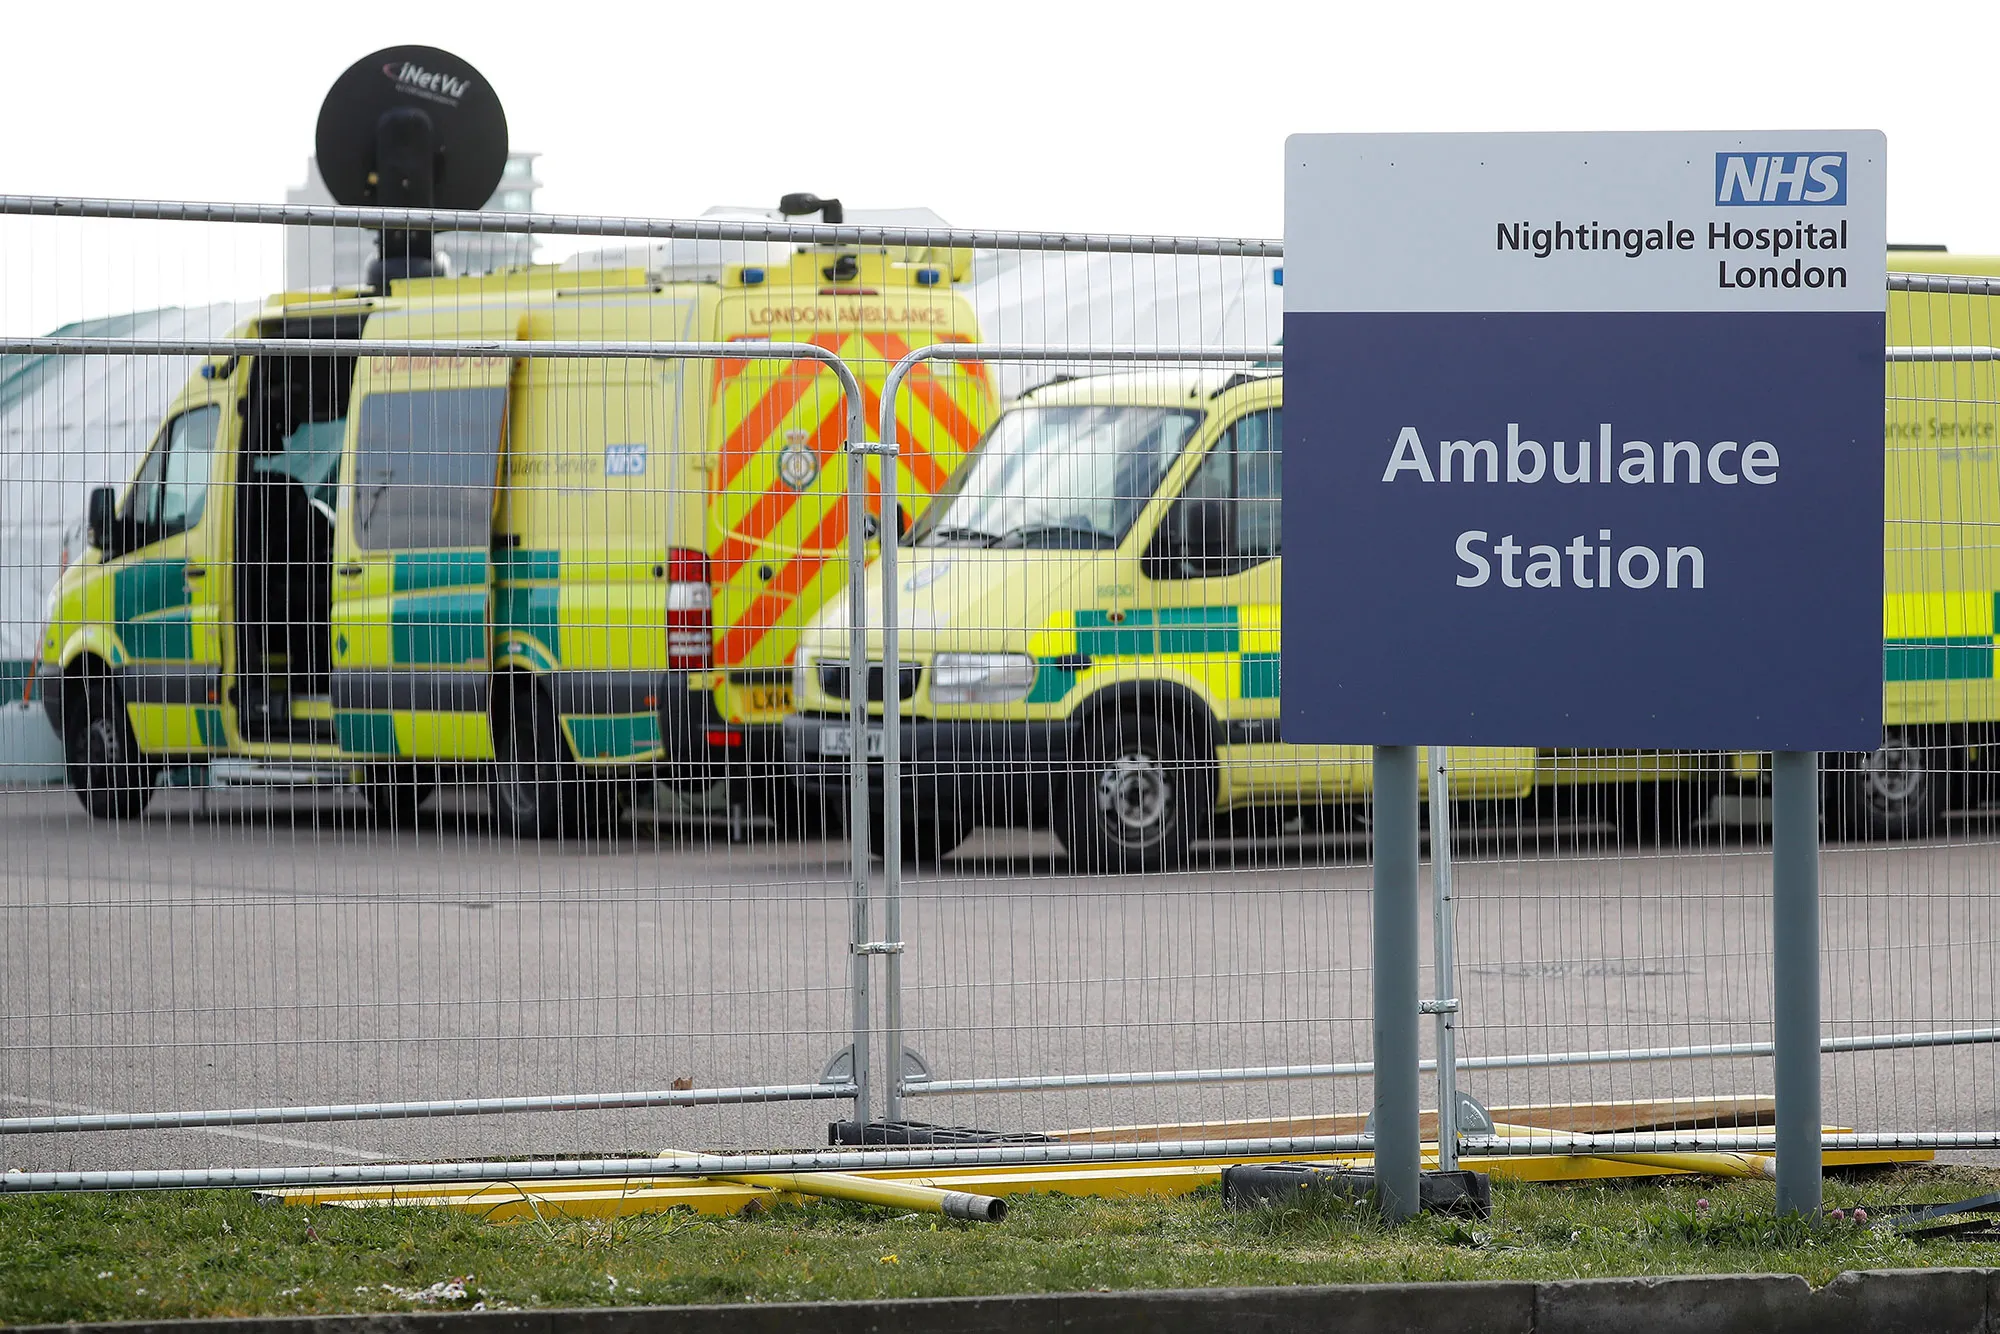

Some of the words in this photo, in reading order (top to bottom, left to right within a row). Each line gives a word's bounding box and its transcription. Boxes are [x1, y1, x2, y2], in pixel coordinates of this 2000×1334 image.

[1716, 152, 1847, 206] NHS
[1498, 219, 1695, 259] Nightingale
[1708, 219, 1847, 258] Hospital
[1719, 258, 1847, 289] London
[749, 307, 831, 325] LONDON
[838, 306, 947, 325] AMBULANCE
[1928, 416, 1993, 438] Service
[606, 445, 646, 476] NHS
[1381, 423, 1780, 486] Ambulance
[1455, 529, 1704, 589] Station
